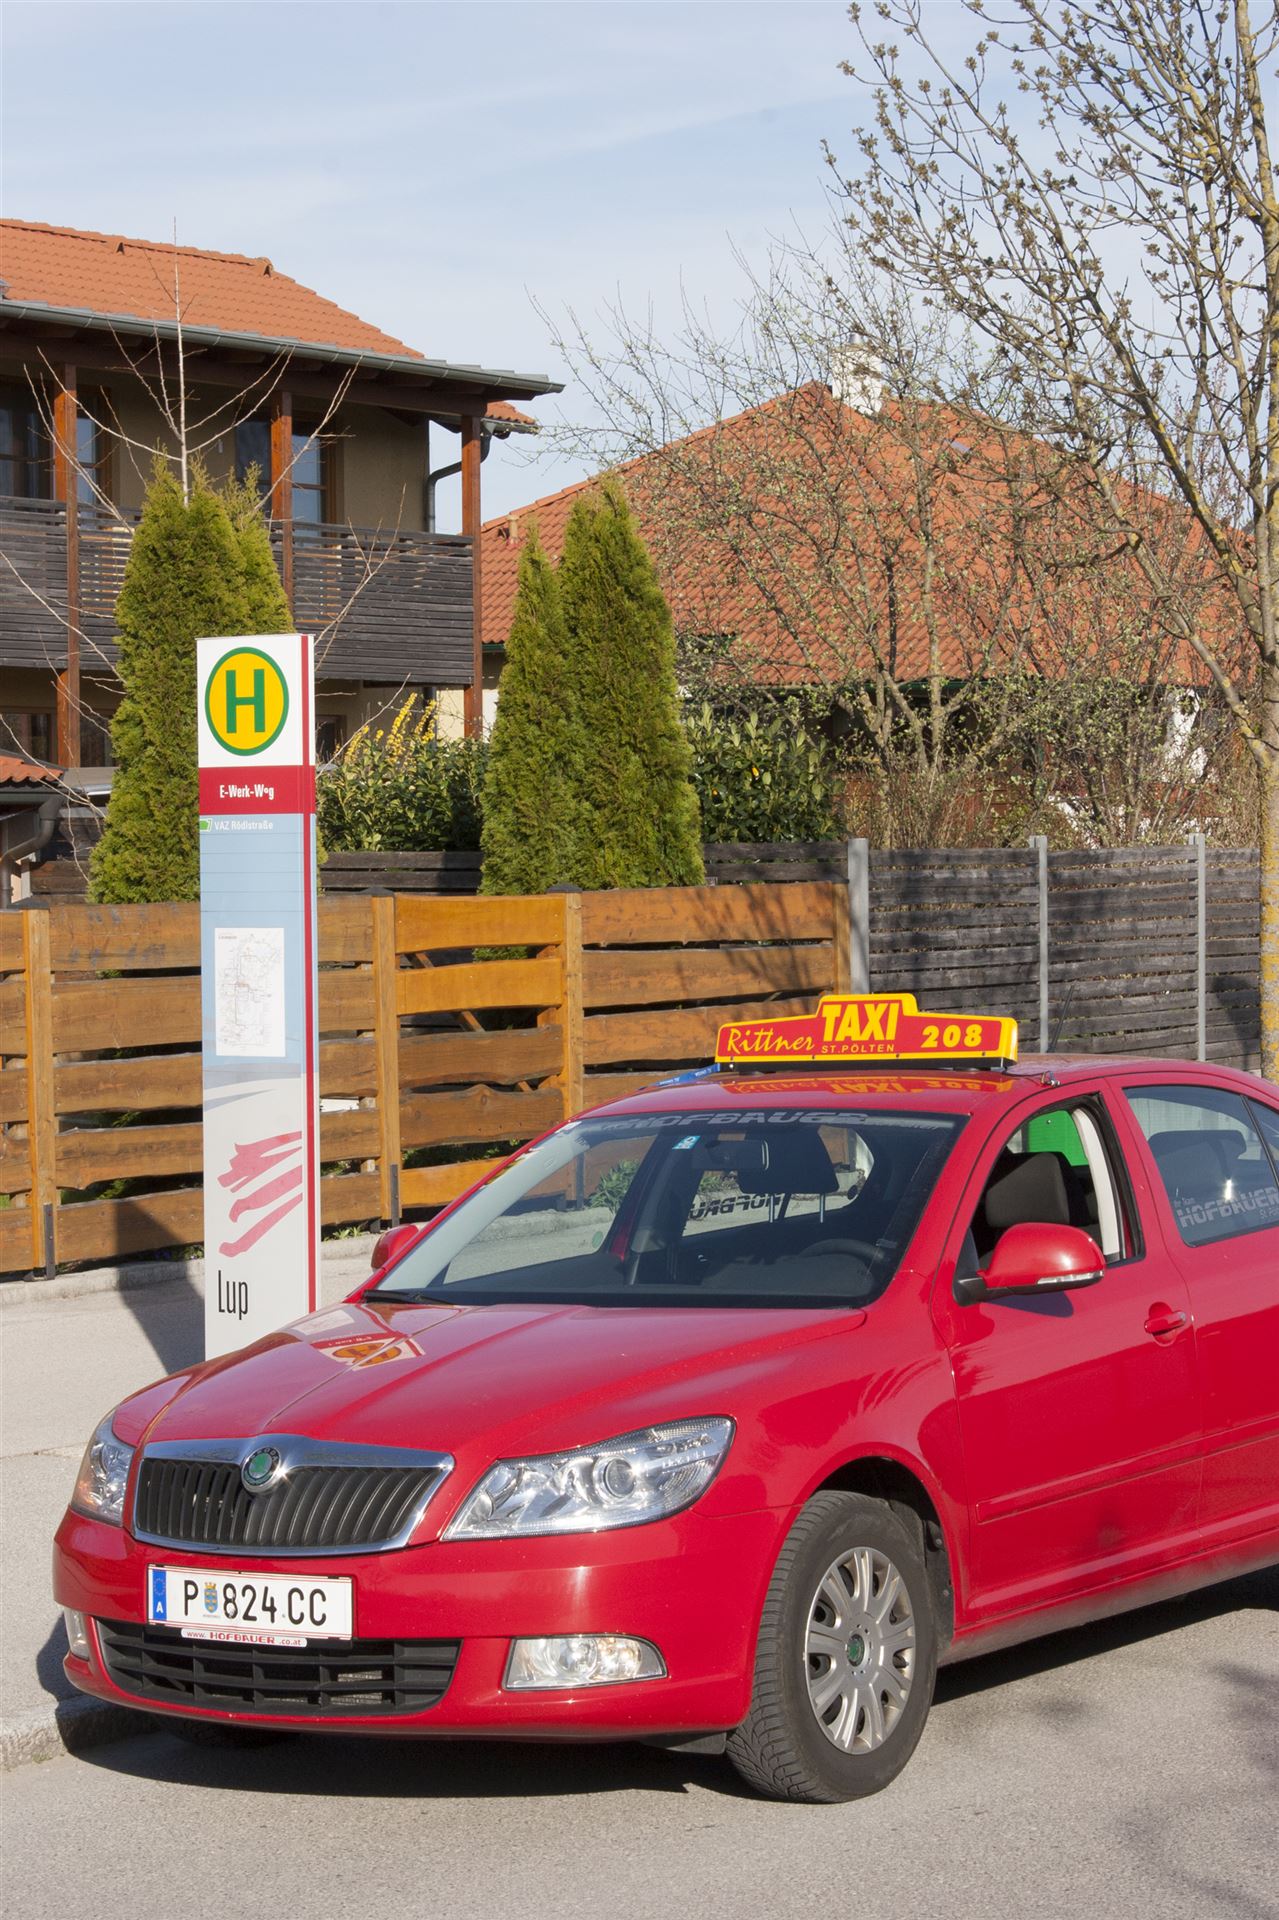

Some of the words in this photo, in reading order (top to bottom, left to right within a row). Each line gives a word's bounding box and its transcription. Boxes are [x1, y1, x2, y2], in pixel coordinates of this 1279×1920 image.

[226, 669, 265, 733] H
[214, 821, 229, 831] VAZ
[822, 1003, 900, 1042] TAXI
[727, 1028, 815, 1054] Rittner
[821, 1043, 895, 1054] ST.PÖLTEN
[921, 1024, 983, 1048] 208
[218, 1270, 249, 1320] Lup
[156, 1601, 164, 1613] A
[184, 1580, 198, 1616] P
[223, 1583, 277, 1623] 824
[288, 1587, 326, 1626] CC
[210, 1632, 275, 1644] HOFBAUER
